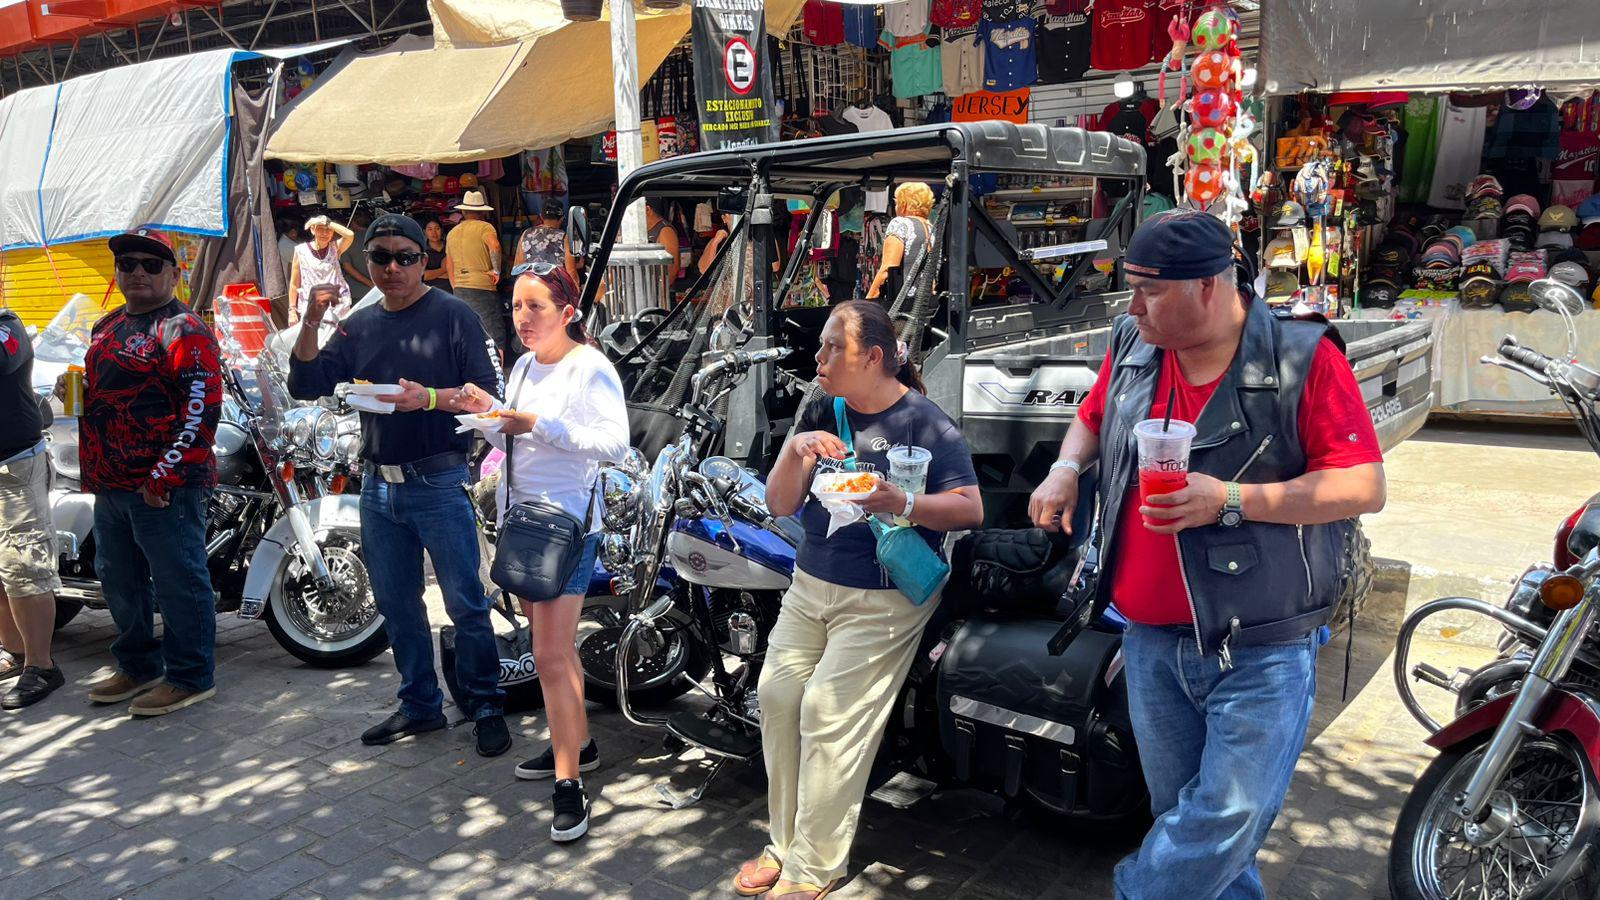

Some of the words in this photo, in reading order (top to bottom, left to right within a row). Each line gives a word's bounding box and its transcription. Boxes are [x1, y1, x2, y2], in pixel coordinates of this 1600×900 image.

[720, 13, 754, 31] BIKERS
[731, 49, 749, 82] E
[957, 94, 1030, 116] JERSEY
[1370, 396, 1402, 425] POLARIS
